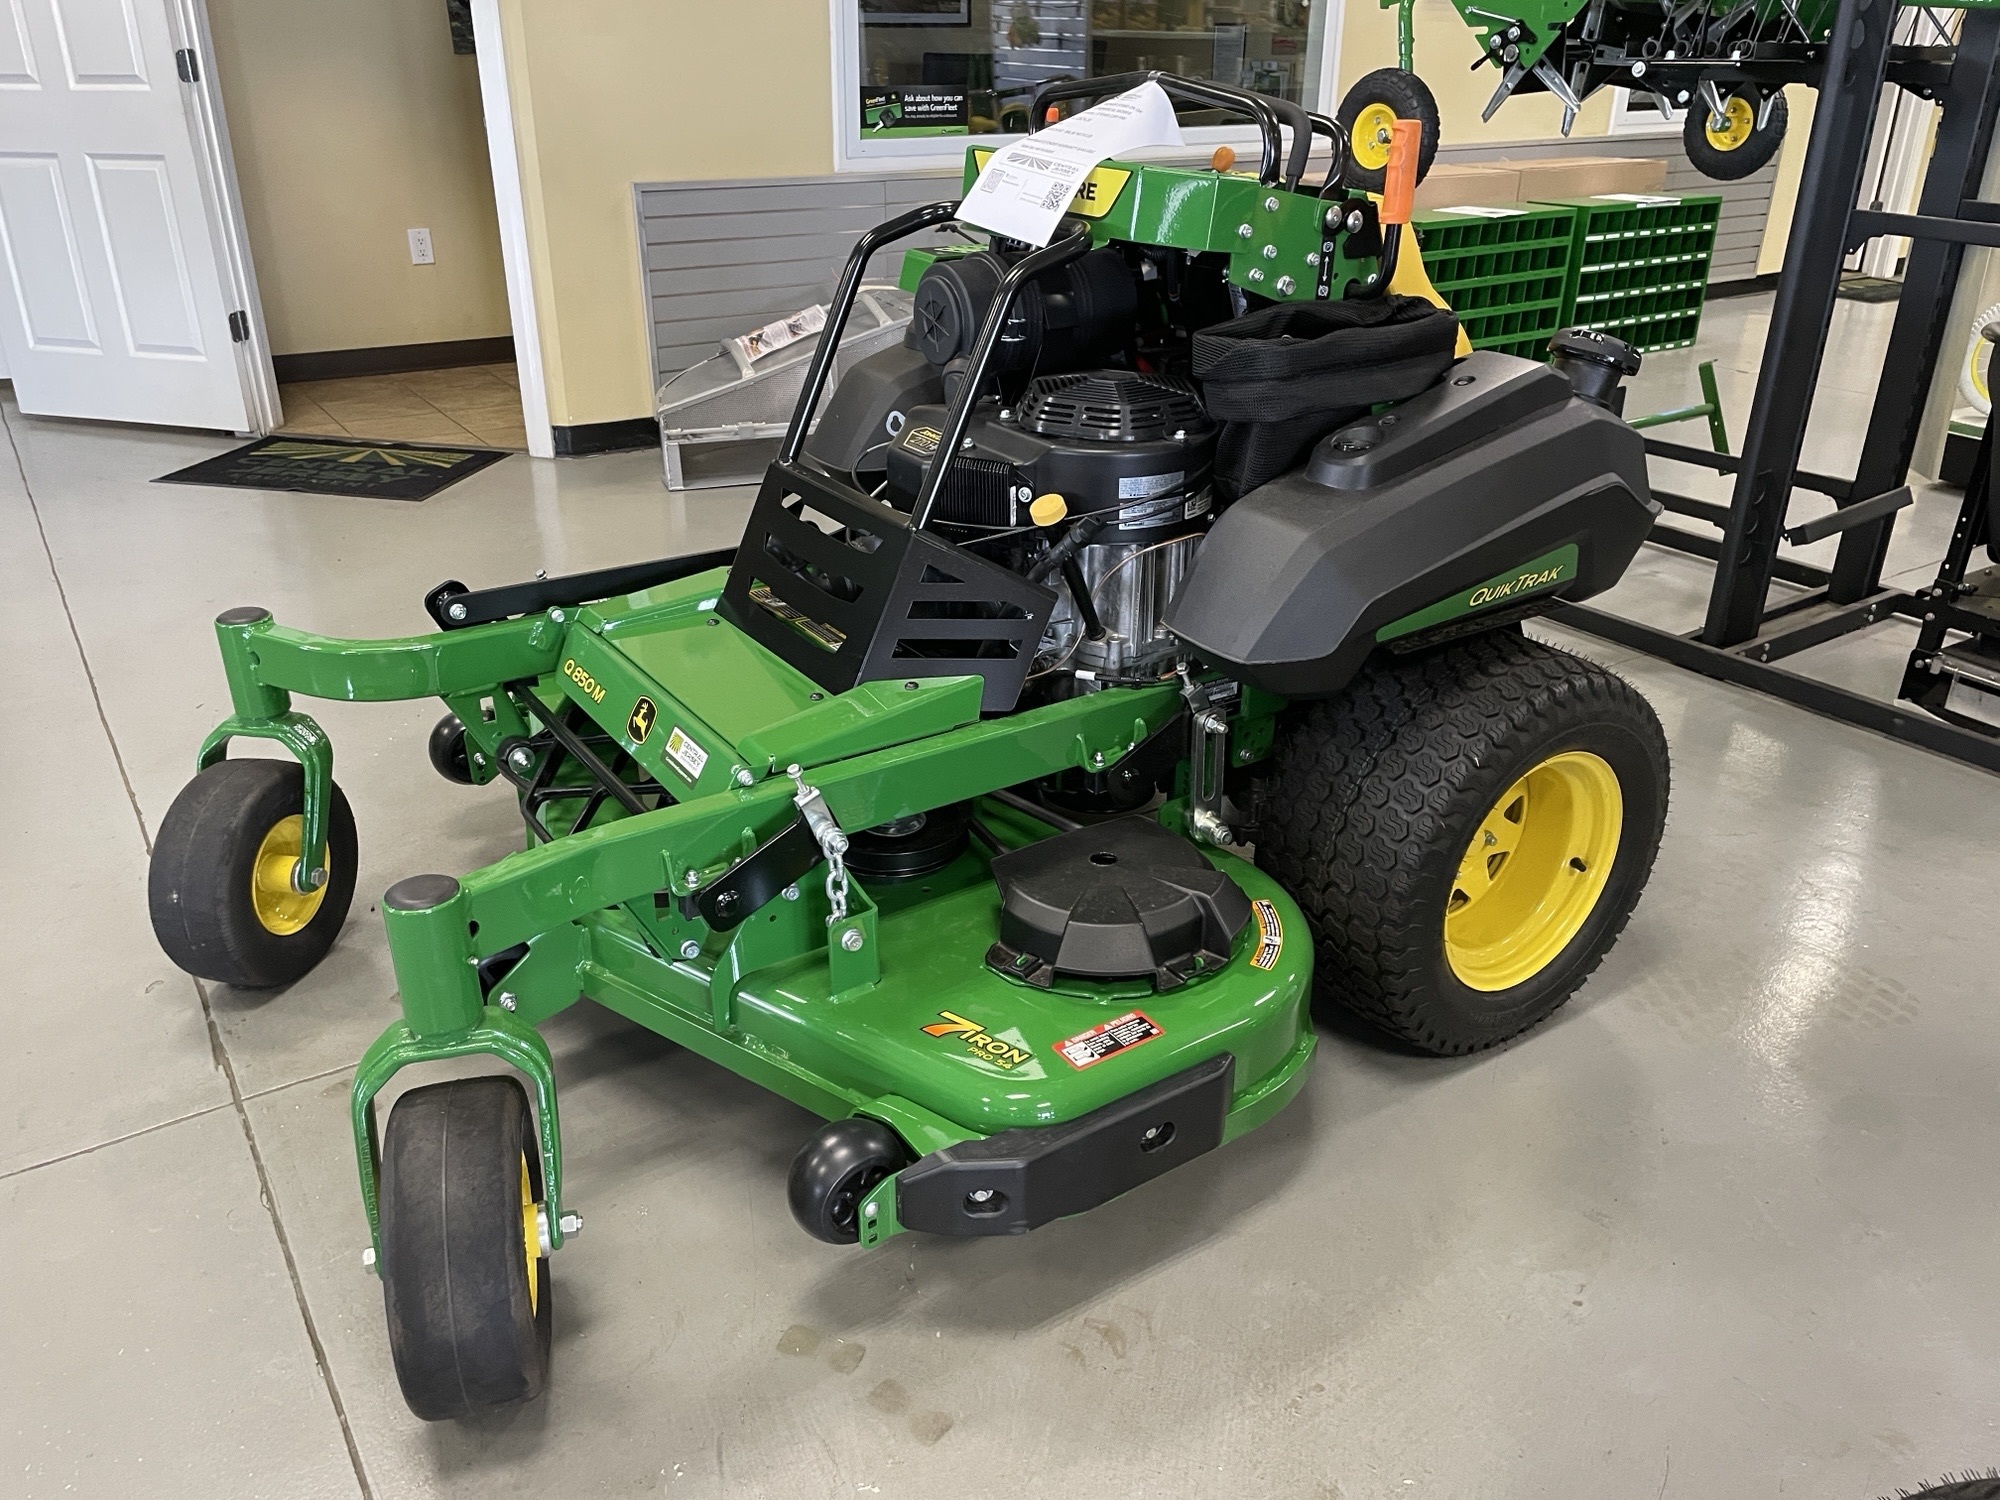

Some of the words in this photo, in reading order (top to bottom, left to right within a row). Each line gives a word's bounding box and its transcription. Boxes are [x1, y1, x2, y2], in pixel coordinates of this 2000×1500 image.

[904, 94, 914, 102] Ask
[915, 94, 931, 102] about
[931, 94, 942, 102] how
[943, 95, 953, 103] you
[930, 103, 958, 111] GreenFleet
[1075, 181, 1097, 201] RE
[957, 1029, 1033, 1064] IRON
[966, 1046, 994, 1061] PRO
